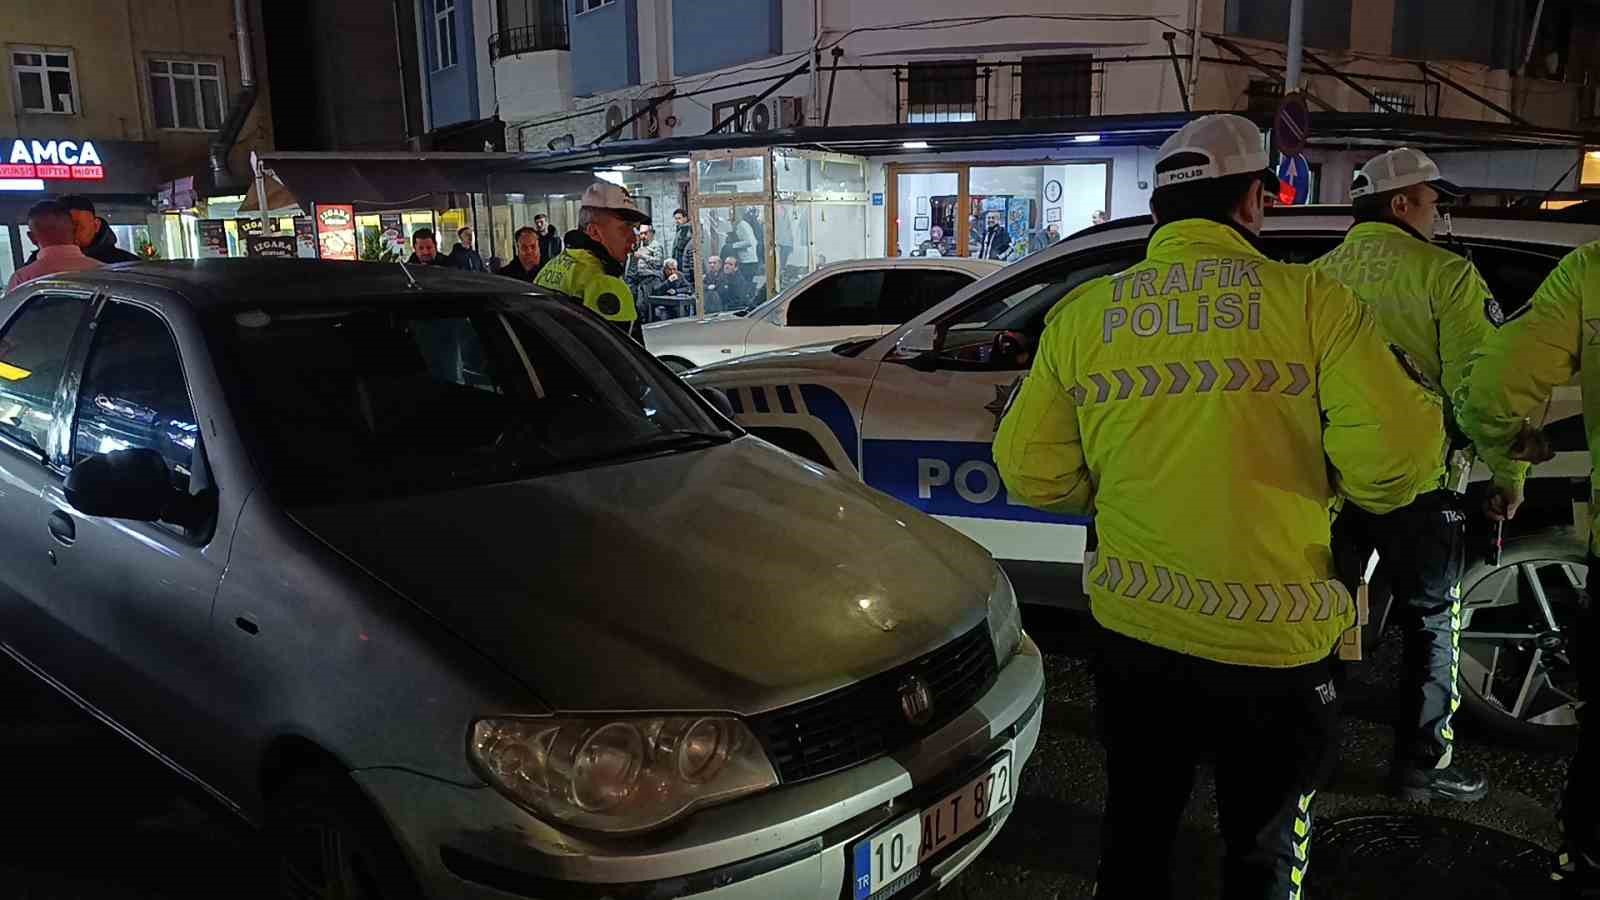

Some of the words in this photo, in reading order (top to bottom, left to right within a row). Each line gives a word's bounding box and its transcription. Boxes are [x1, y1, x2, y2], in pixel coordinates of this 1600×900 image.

[10, 140, 102, 165] AMCA
[875, 832, 904, 883] 10
[922, 795, 963, 858] ALT
[974, 765, 1008, 819] 872
[856, 874, 870, 891] TR
